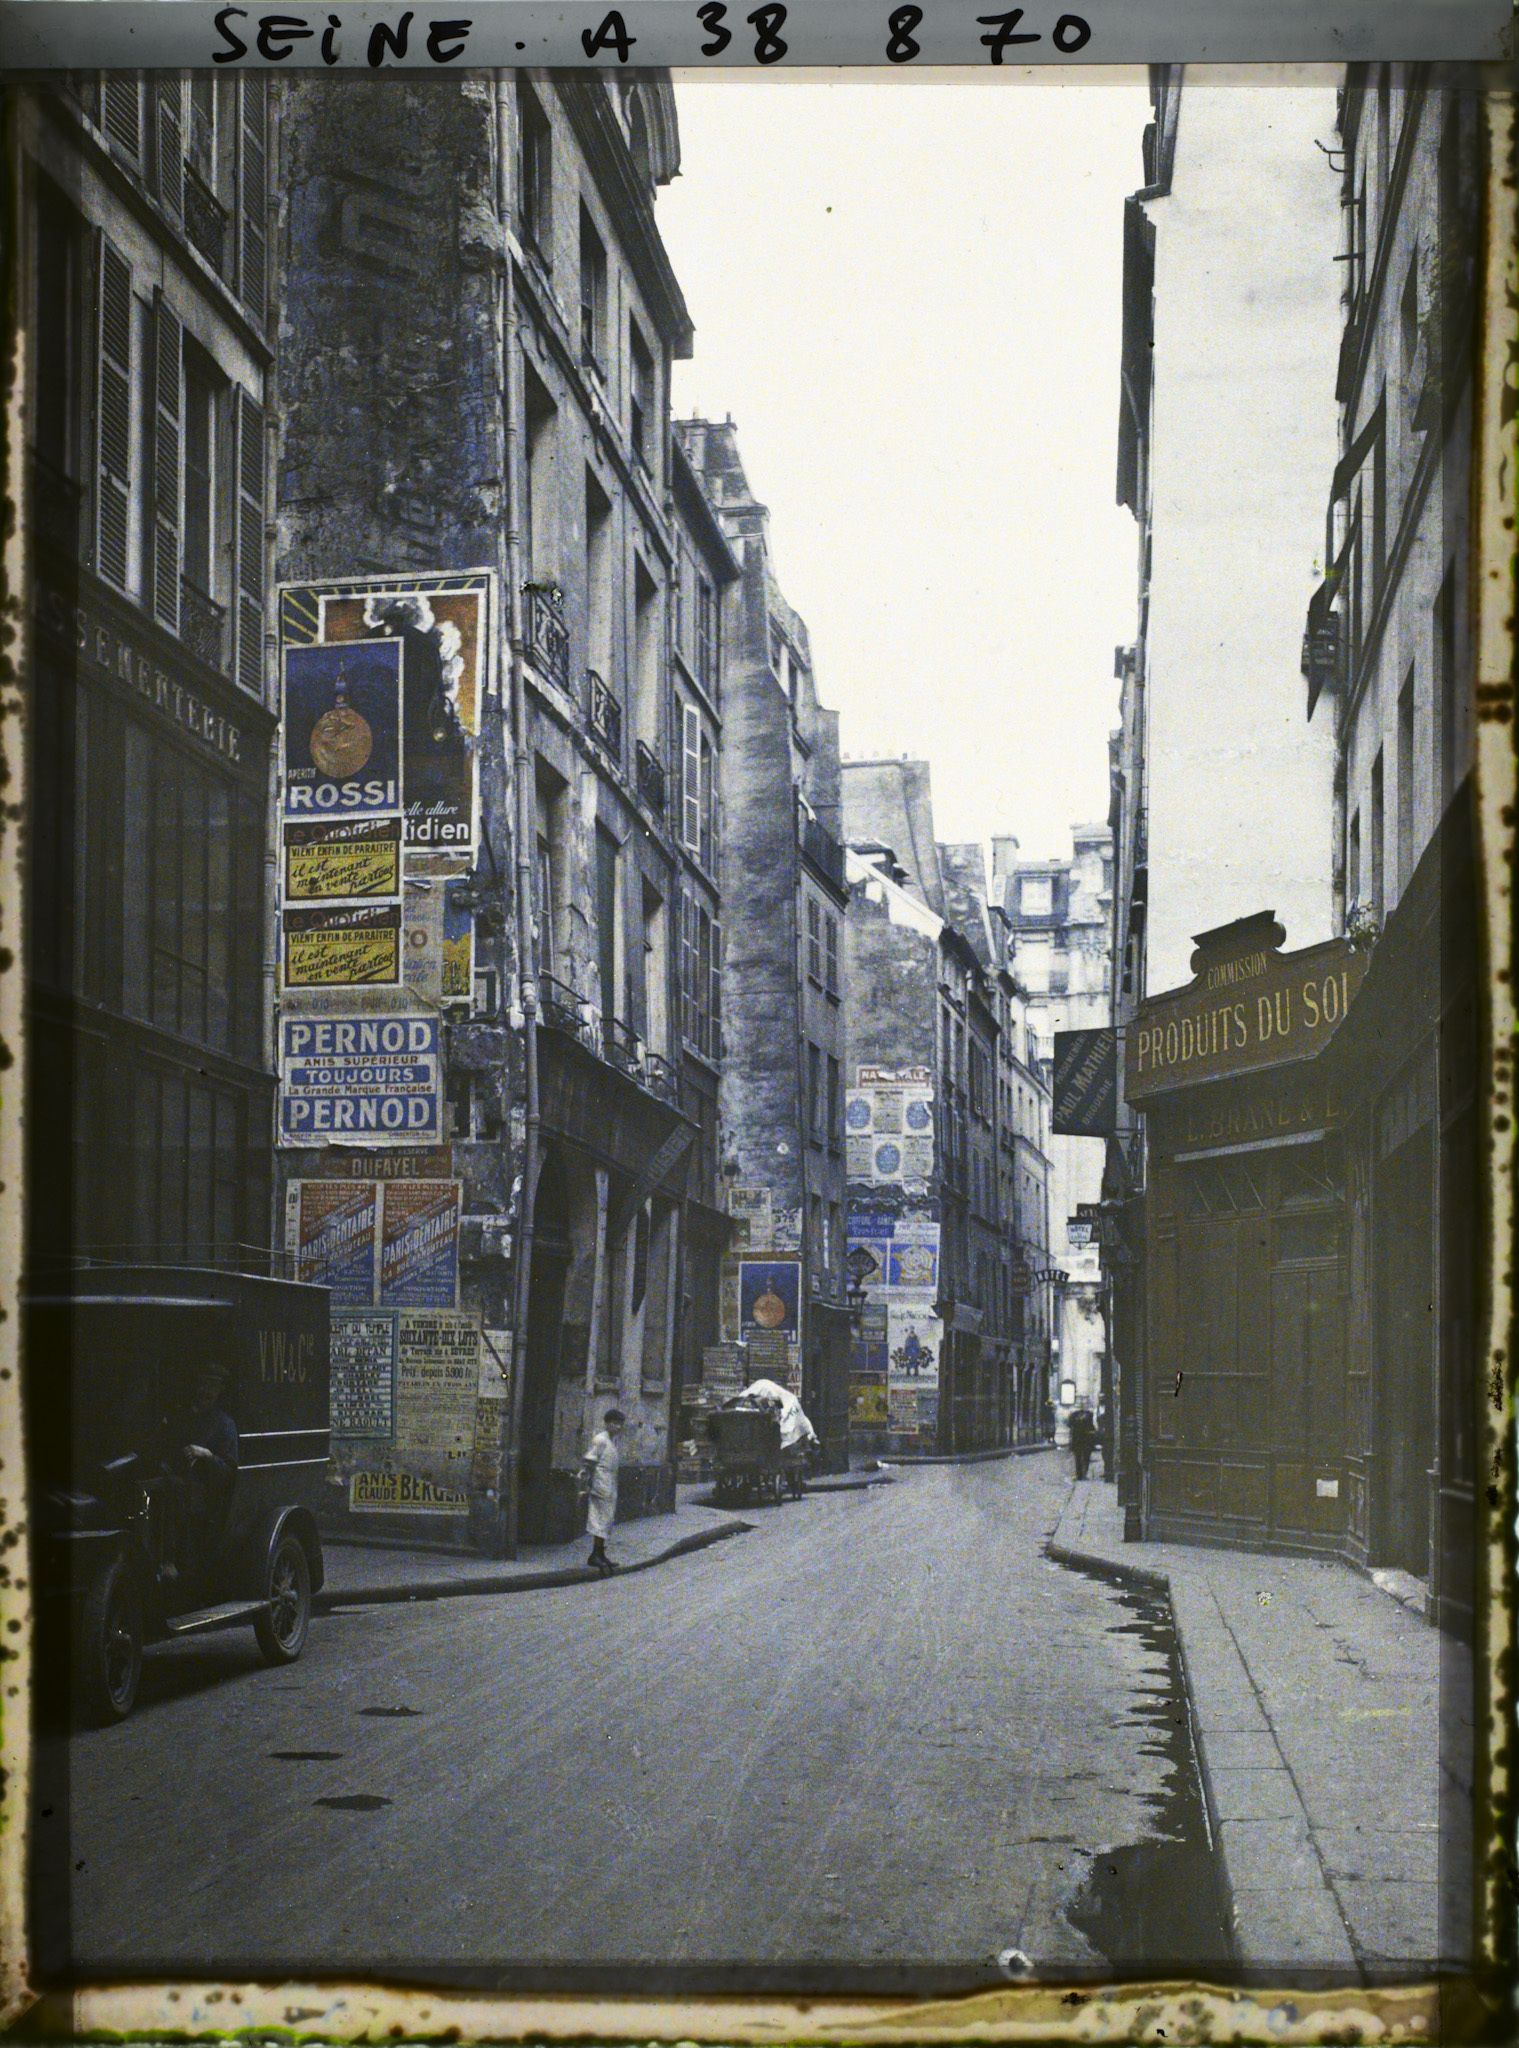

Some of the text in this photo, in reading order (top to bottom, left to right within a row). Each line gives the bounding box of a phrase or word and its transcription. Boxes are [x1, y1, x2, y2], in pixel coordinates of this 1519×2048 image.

[582, 10, 637, 63] A
[289, 780, 396, 809] ROSSI
[291, 847, 315, 857] VIENT
[316, 845, 340, 855] ENFIN
[342, 844, 352, 855] DE
[290, 933, 314, 943] VIENT
[316, 932, 340, 942] ENFIN
[341, 931, 351, 941] DE
[1206, 951, 1268, 991] COMMISSION
[291, 1021, 432, 1054] PERNOD
[1137, 1003, 1247, 1072] PRODUITS
[1257, 988, 1291, 1042] DU
[304, 1057, 335, 1067] ANIS
[306, 1068, 414, 1084] TOUJOURS
[1053, 1029, 1116, 1125] PAUL MATHIEU
[288, 1086, 299, 1095] La
[303, 1085, 341, 1095] Grande
[345, 1085, 381, 1097] Marque
[289, 1098, 430, 1130] PERNOD
[352, 1159, 420, 1176] DUFAYEL
[359, 1473, 397, 1486] ANIS
[358, 1486, 396, 1500] CLAUDE
